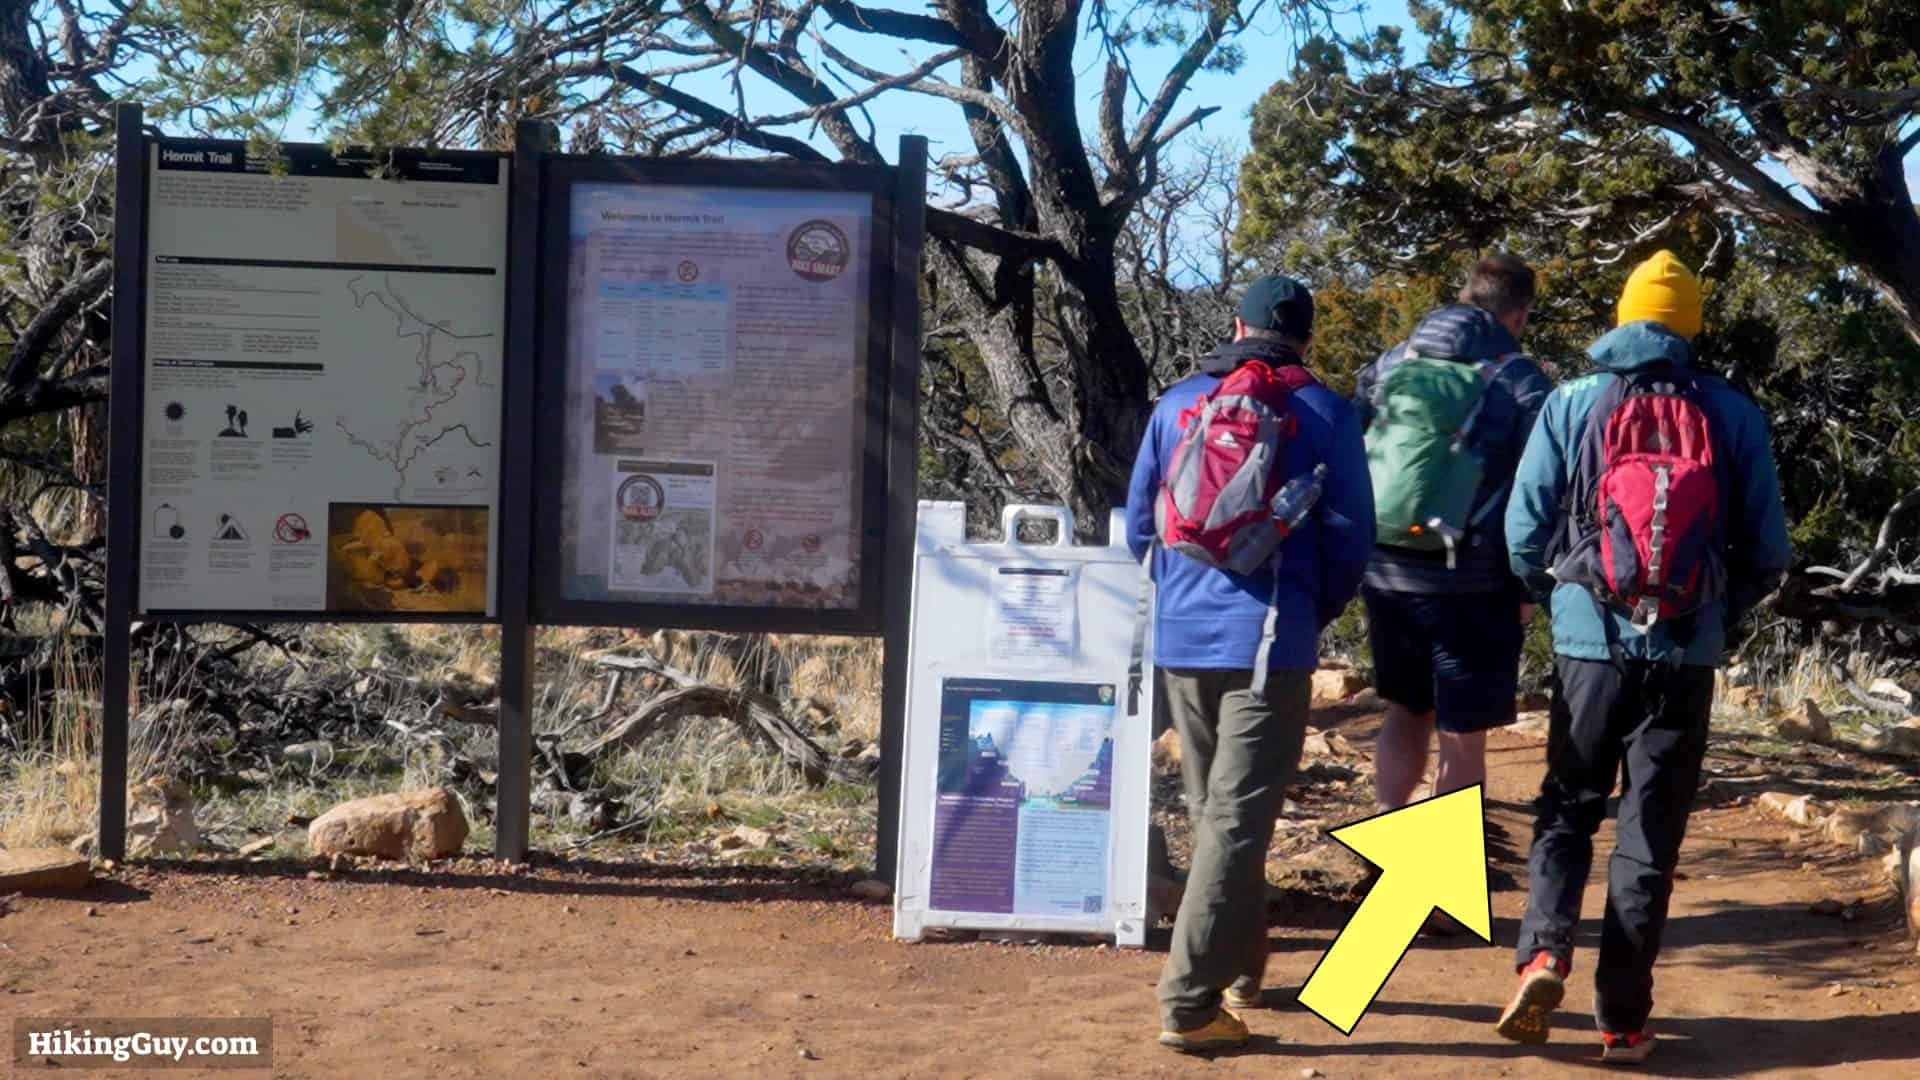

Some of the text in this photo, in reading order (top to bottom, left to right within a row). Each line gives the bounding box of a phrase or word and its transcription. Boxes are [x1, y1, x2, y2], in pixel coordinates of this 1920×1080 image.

[163, 150, 204, 163] Hermit
[208, 152, 232, 164] Trail
[601, 210, 725, 224] Welcome to Hermit Trail
